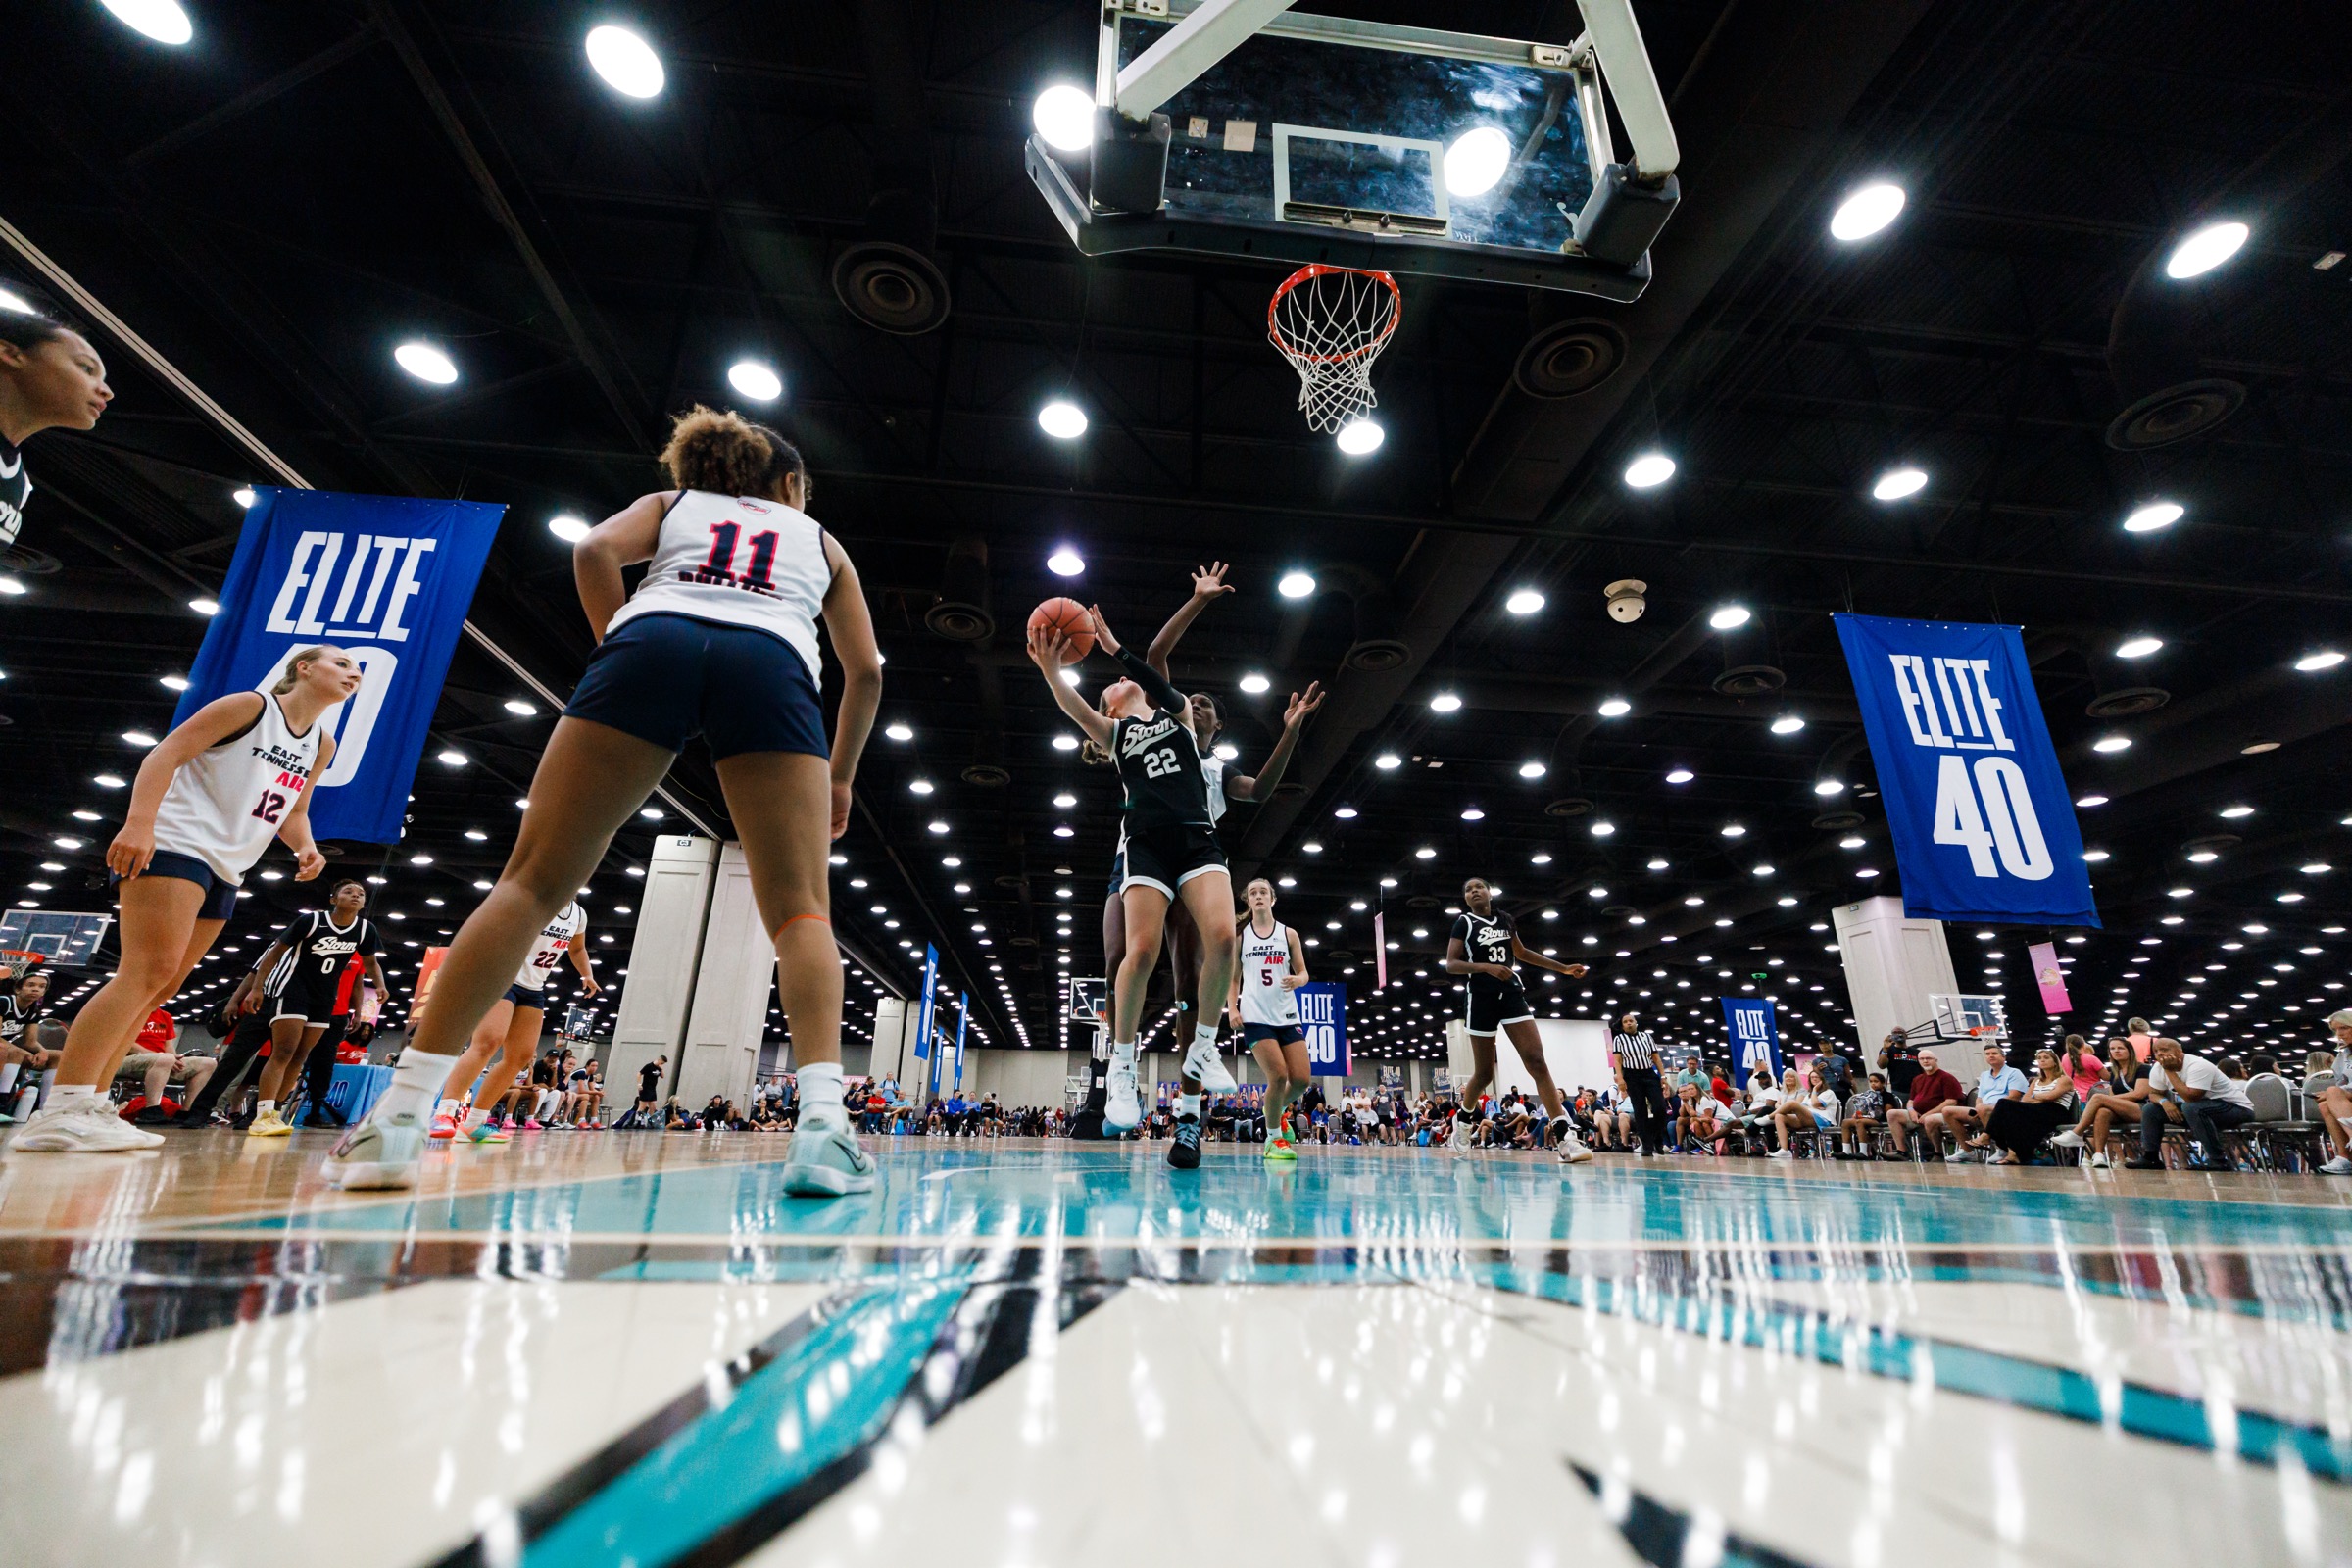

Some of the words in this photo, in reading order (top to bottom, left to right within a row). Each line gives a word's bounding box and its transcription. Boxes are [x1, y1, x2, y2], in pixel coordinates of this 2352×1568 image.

[698, 519, 780, 591] 11
[266, 531, 437, 642] ELITE
[1888, 654, 2016, 752] ELITE
[1122, 717, 1179, 757] Storm
[270, 744, 302, 763] EAST
[1144, 747, 1182, 780] 22
[275, 770, 305, 793] AIR
[251, 788, 286, 825] 12
[1934, 755, 2054, 881] 40
[548, 925, 569, 935] EAST
[311, 936, 357, 955] Storm
[1245, 950, 1287, 958] TENNESSEE
[1488, 946, 1506, 963] 33
[320, 957, 336, 975] 0
[532, 950, 558, 969] 22
[1264, 956, 1285, 965] AIR
[1261, 968, 1273, 987] 5
[1300, 993, 1335, 1024] ELITE
[1735, 1008, 1769, 1041] ELITE
[1305, 1025, 1337, 1064] 40
